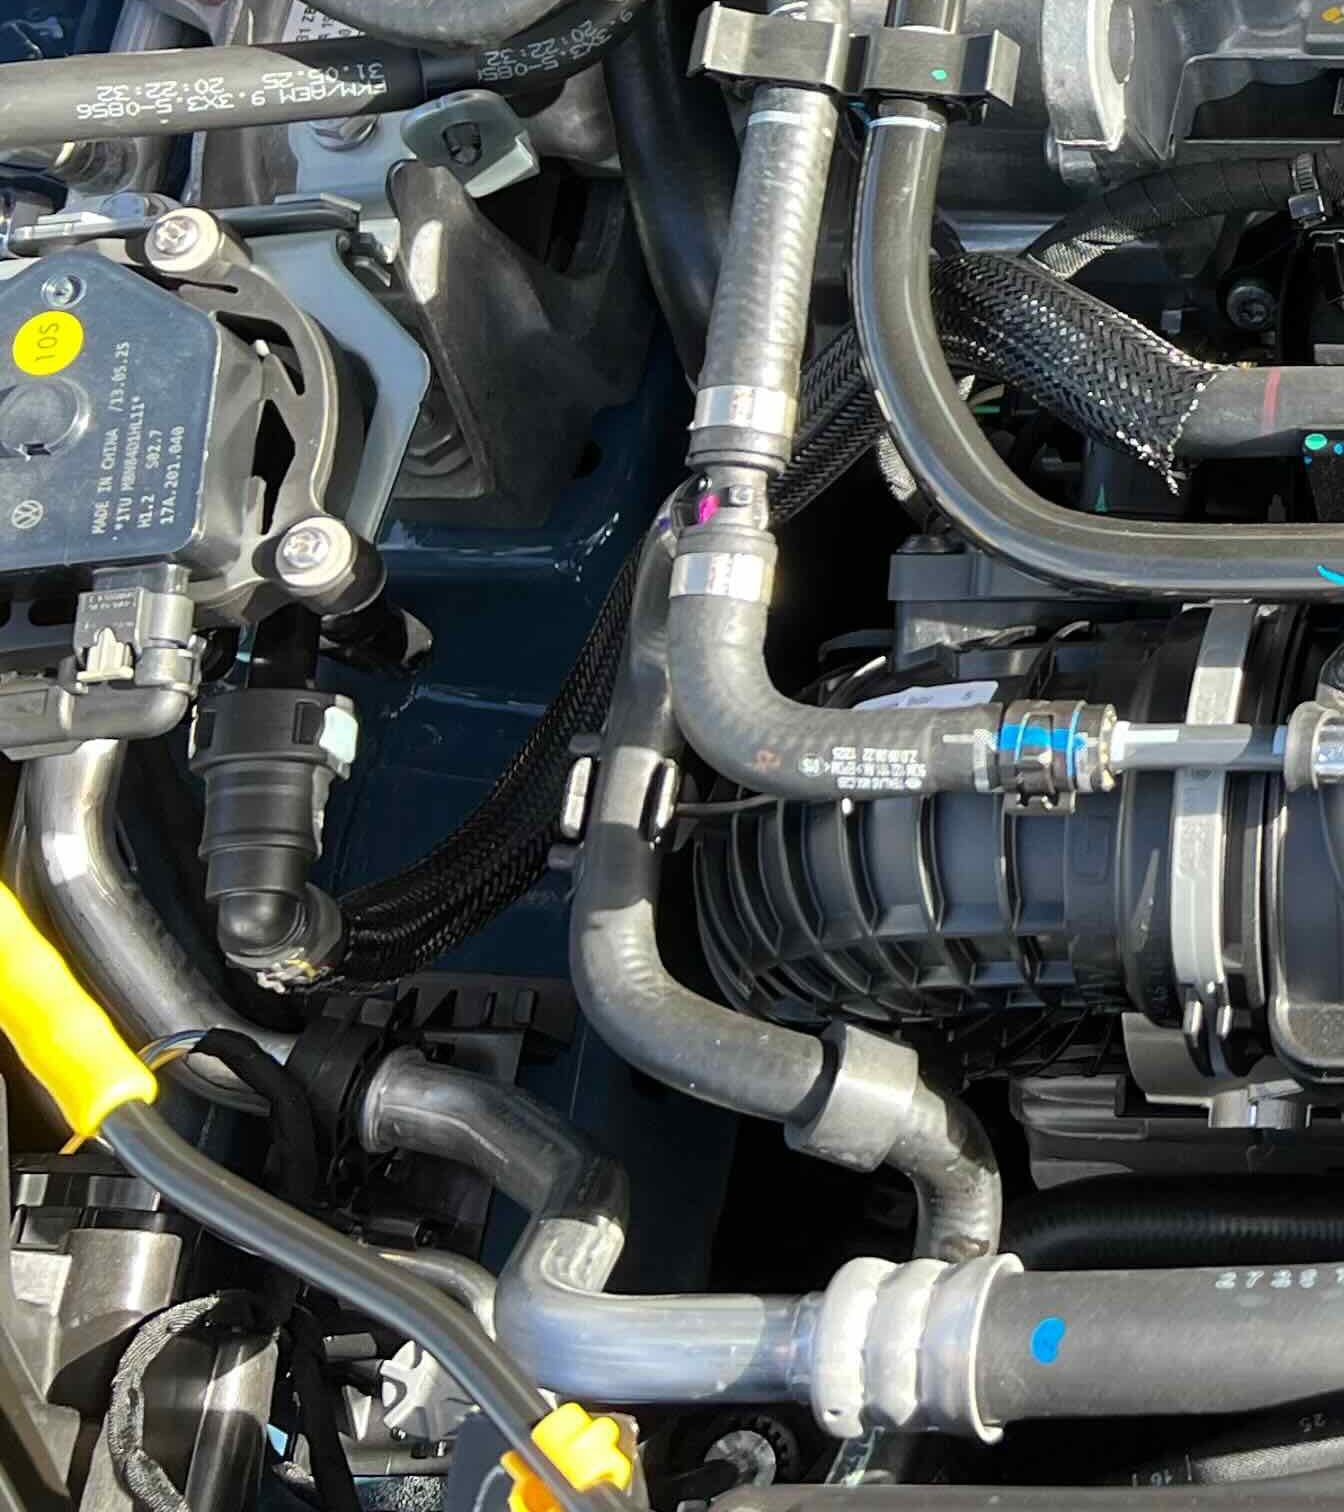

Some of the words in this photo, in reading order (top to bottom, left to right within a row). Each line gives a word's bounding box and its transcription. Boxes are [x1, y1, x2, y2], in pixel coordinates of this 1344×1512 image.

[96, 76, 224, 103] 20:22:32
[101, 428, 119, 470] CHINA
[98, 475, 112, 493] IN
[91, 500, 110, 535] MADE
